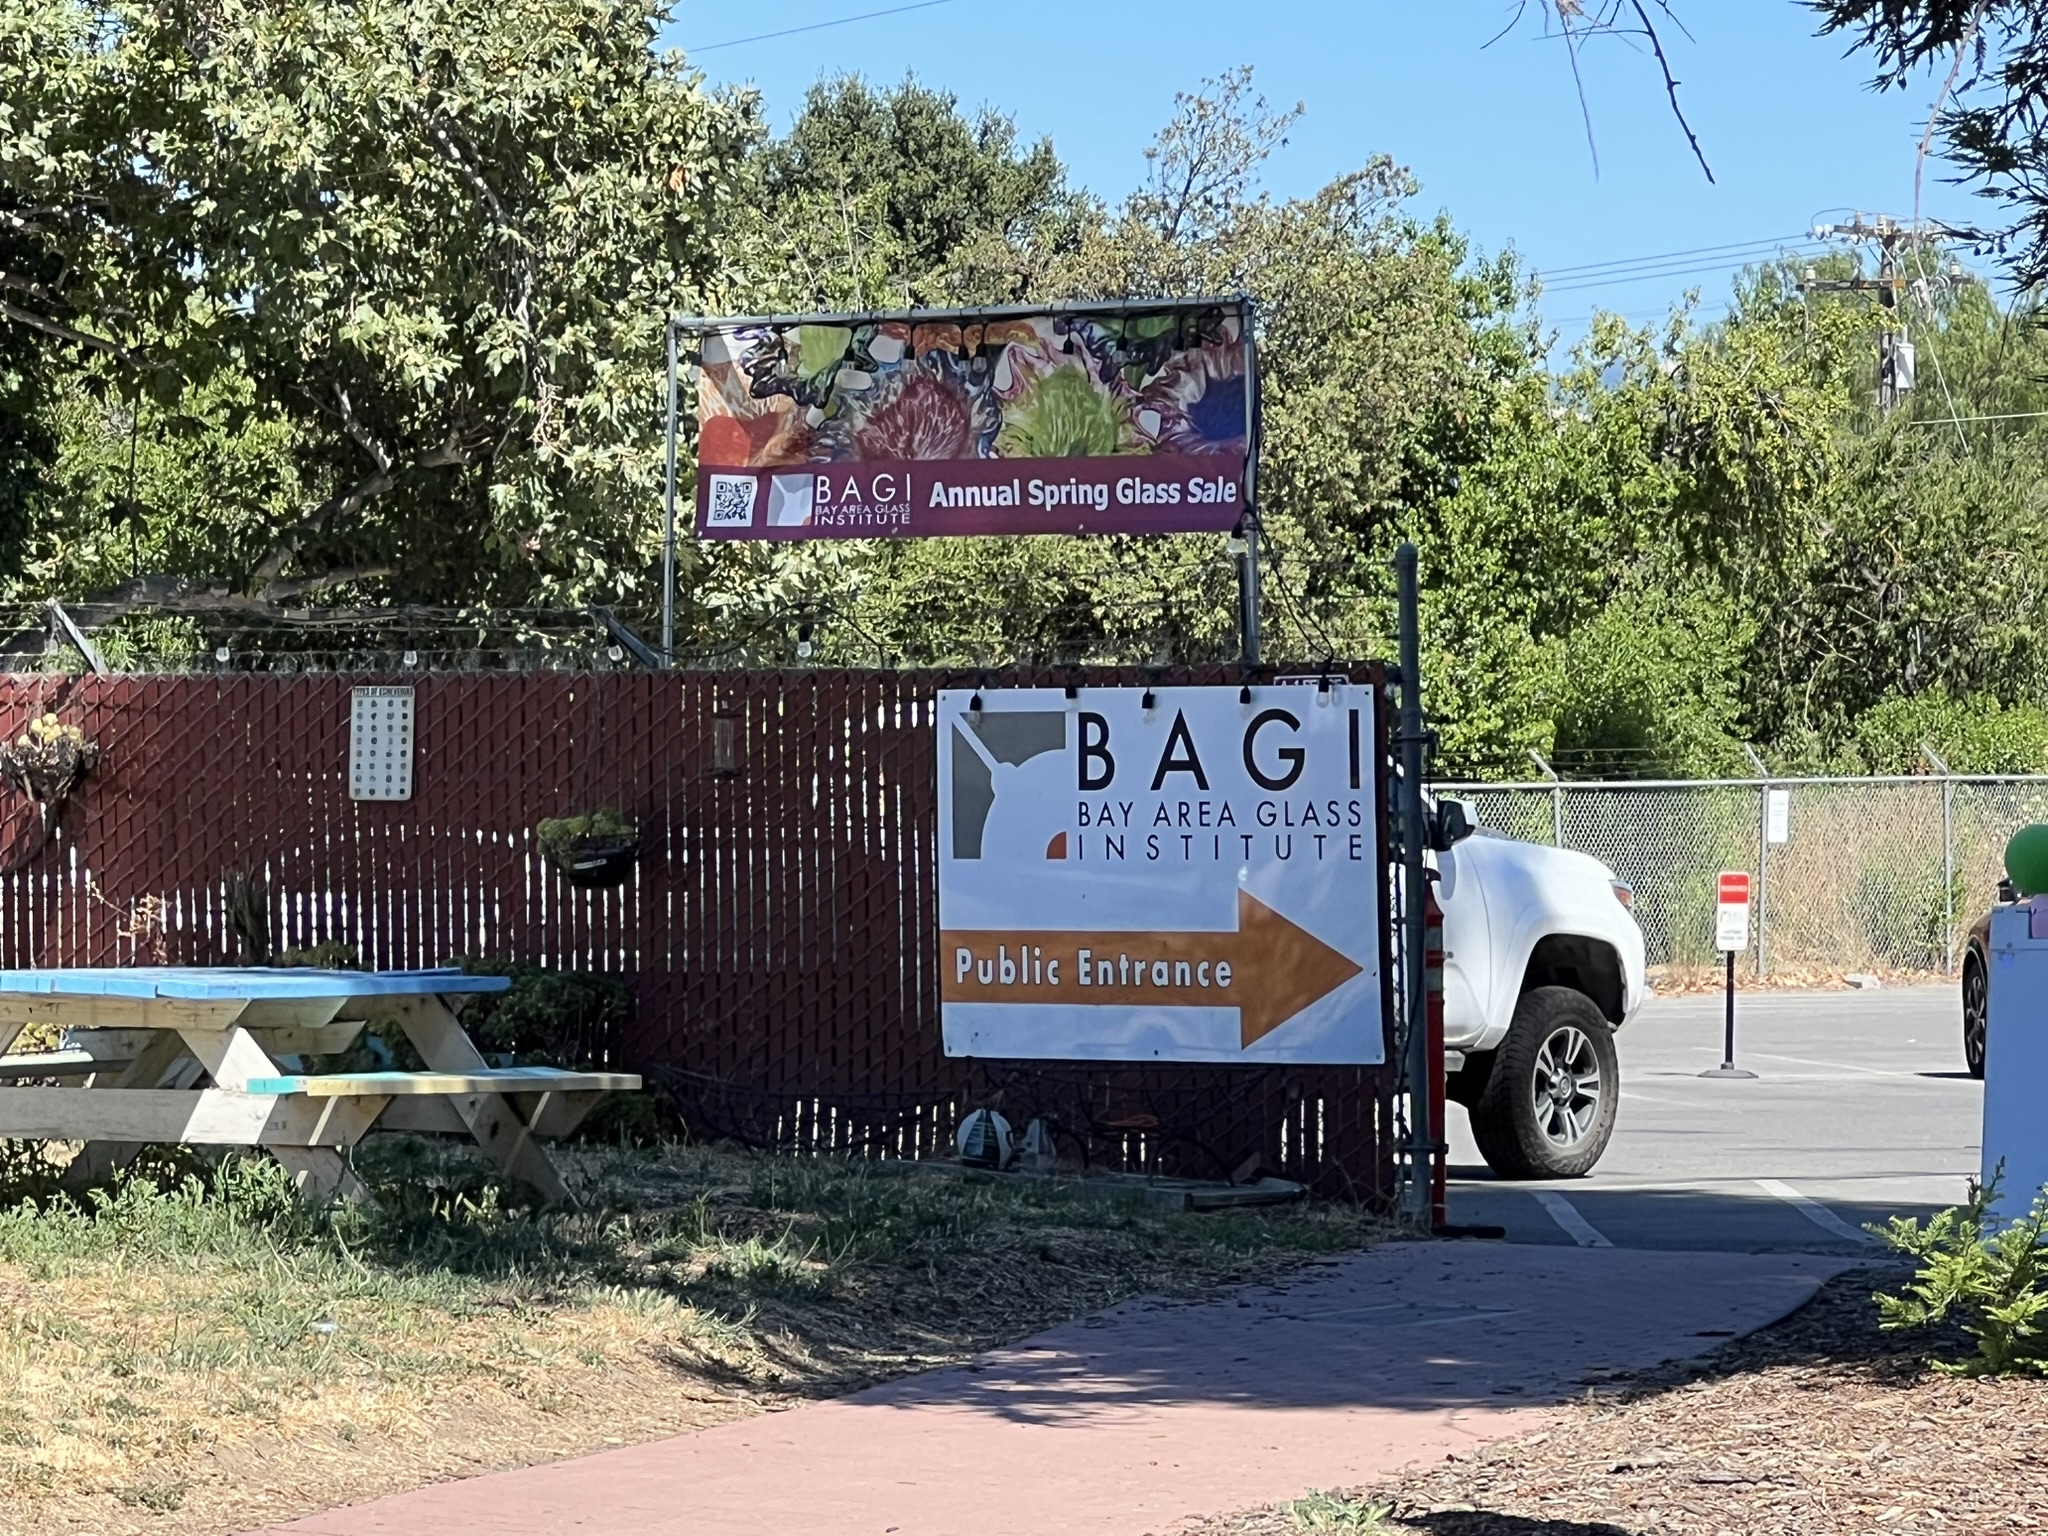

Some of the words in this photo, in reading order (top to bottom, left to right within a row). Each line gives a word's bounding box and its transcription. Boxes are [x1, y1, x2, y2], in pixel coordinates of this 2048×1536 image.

[816, 473, 911, 504] BAGI
[929, 478, 1020, 508] Annual
[1028, 478, 1108, 511] Spring
[1116, 477, 1181, 505] Glass
[1187, 476, 1237, 504] Sale
[814, 512, 911, 526] INSTITUTE
[815, 505, 837, 515] BAY
[840, 505, 871, 515] AREA
[874, 503, 911, 514] GLASS
[1078, 707, 1361, 791] BAGI
[1078, 801, 1134, 828] BAY
[1153, 800, 1236, 828] AREA
[1256, 800, 1362, 828] GLASS
[1078, 834, 1362, 860] INSTITUTE
[955, 945, 1060, 985] Public
[1078, 949, 1232, 988] Entrance
